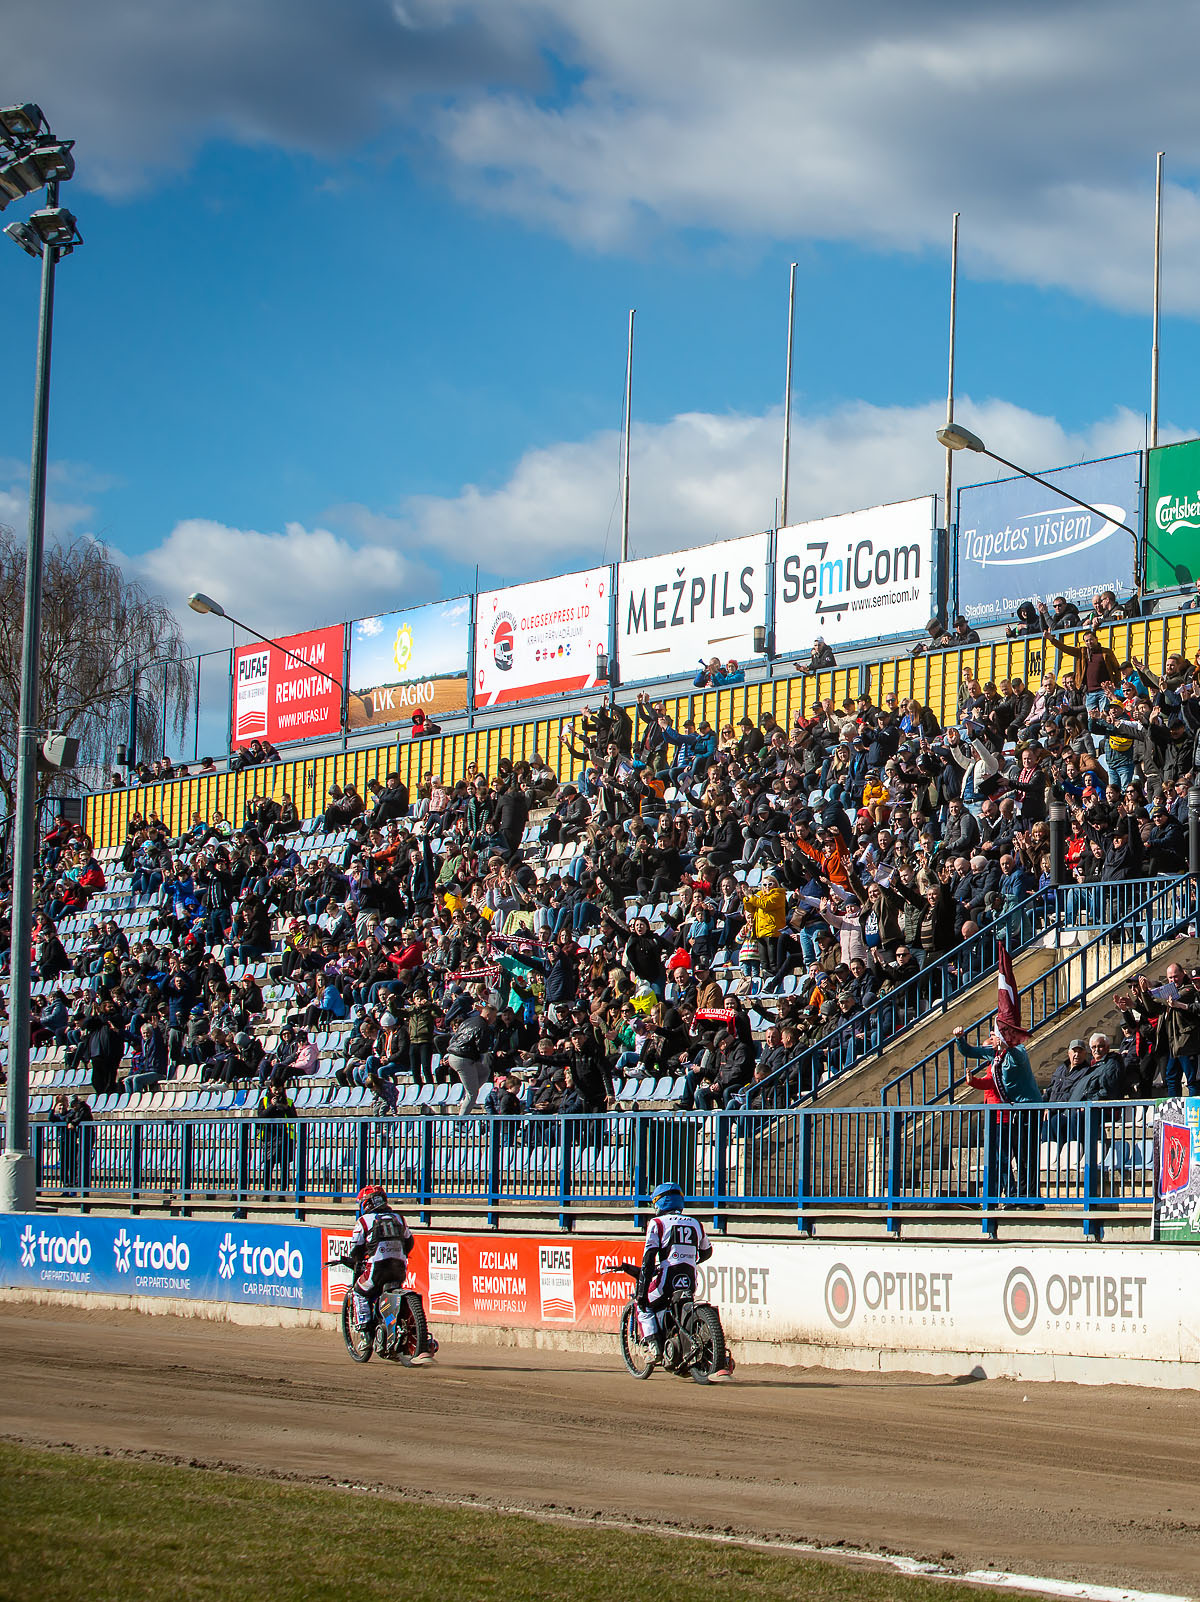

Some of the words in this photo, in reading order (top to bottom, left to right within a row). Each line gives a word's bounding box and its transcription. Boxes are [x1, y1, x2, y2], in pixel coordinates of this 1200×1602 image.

[964, 525, 1030, 569] Tapetes
[1034, 514, 1092, 548] visiem
[783, 541, 921, 604] SemiCom
[627, 567, 755, 636] MEŽPILS
[850, 587, 920, 612] www.semicom.lv
[520, 607, 575, 631] OLEGSEXPRESS
[577, 605, 590, 619] LTD
[964, 603, 994, 617] Stadiona
[284, 642, 326, 671] IZCILAM
[239, 655, 268, 681] PUFAS
[275, 673, 333, 704] REMONTAM
[373, 686, 396, 713] LVK
[398, 682, 435, 710] AGRO
[278, 706, 329, 729] WWW.PUFAS.LV
[696, 1007, 735, 1018] LOKOMOTI
[382, 1221, 396, 1237] 11
[677, 1226, 692, 1244] 12
[38, 1230, 92, 1265] trodo
[132, 1234, 190, 1272] trodo
[329, 1239, 353, 1258] PUFA
[430, 1245, 458, 1265] PUFAS
[240, 1240, 303, 1279] trodo
[479, 1251, 518, 1270] IZCILAM
[541, 1250, 571, 1270] PUFAS
[40, 1270, 51, 1281] CAR
[51, 1271, 70, 1282] PARTS
[70, 1272, 91, 1284] ONLINE
[135, 1275, 148, 1287] CAR
[149, 1276, 168, 1288] PARTS
[169, 1278, 190, 1290] ONLINE
[472, 1275, 527, 1295] REMONTAM
[242, 1282, 258, 1295] CAR
[258, 1284, 280, 1297] PARTS
[279, 1286, 303, 1299] ONLINE
[589, 1280, 636, 1300] REMONTA
[863, 1270, 953, 1312] OPTIBET
[1046, 1274, 1147, 1318] OPTIBET
[474, 1298, 527, 1313] WWW.PUFAS.LV
[589, 1303, 626, 1317] WWW.PU
[863, 1314, 914, 1325] SPORTA
[921, 1314, 955, 1328] BĀRS
[1046, 1320, 1101, 1332] SPORTA
[1111, 1320, 1148, 1334] BĀRS
